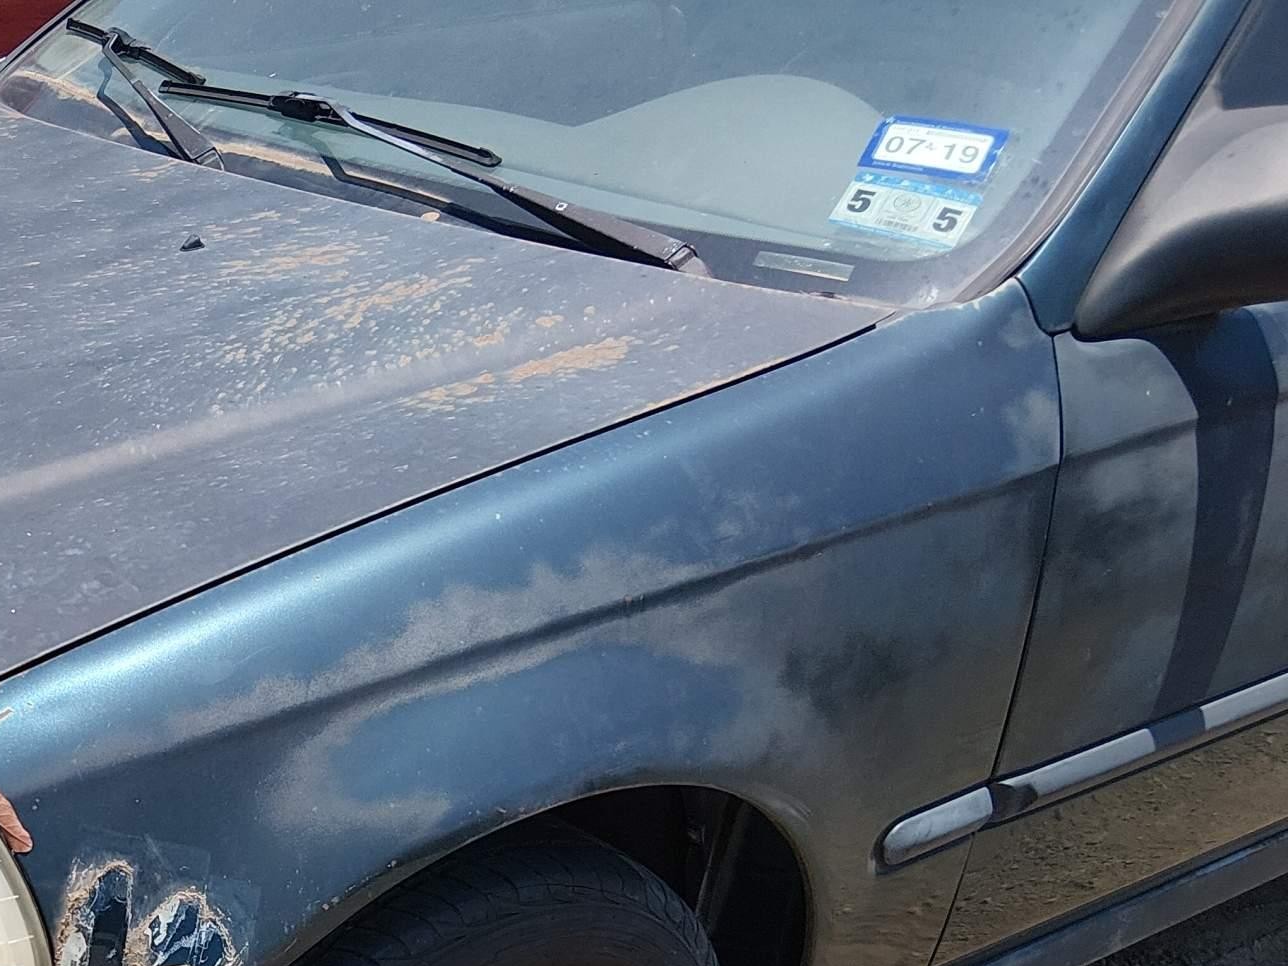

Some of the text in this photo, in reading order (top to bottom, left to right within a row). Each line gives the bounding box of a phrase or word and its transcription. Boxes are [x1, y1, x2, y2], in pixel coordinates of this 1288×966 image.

[885, 135, 980, 164] 07 19
[846, 188, 877, 213] 5
[932, 206, 963, 233] 5
